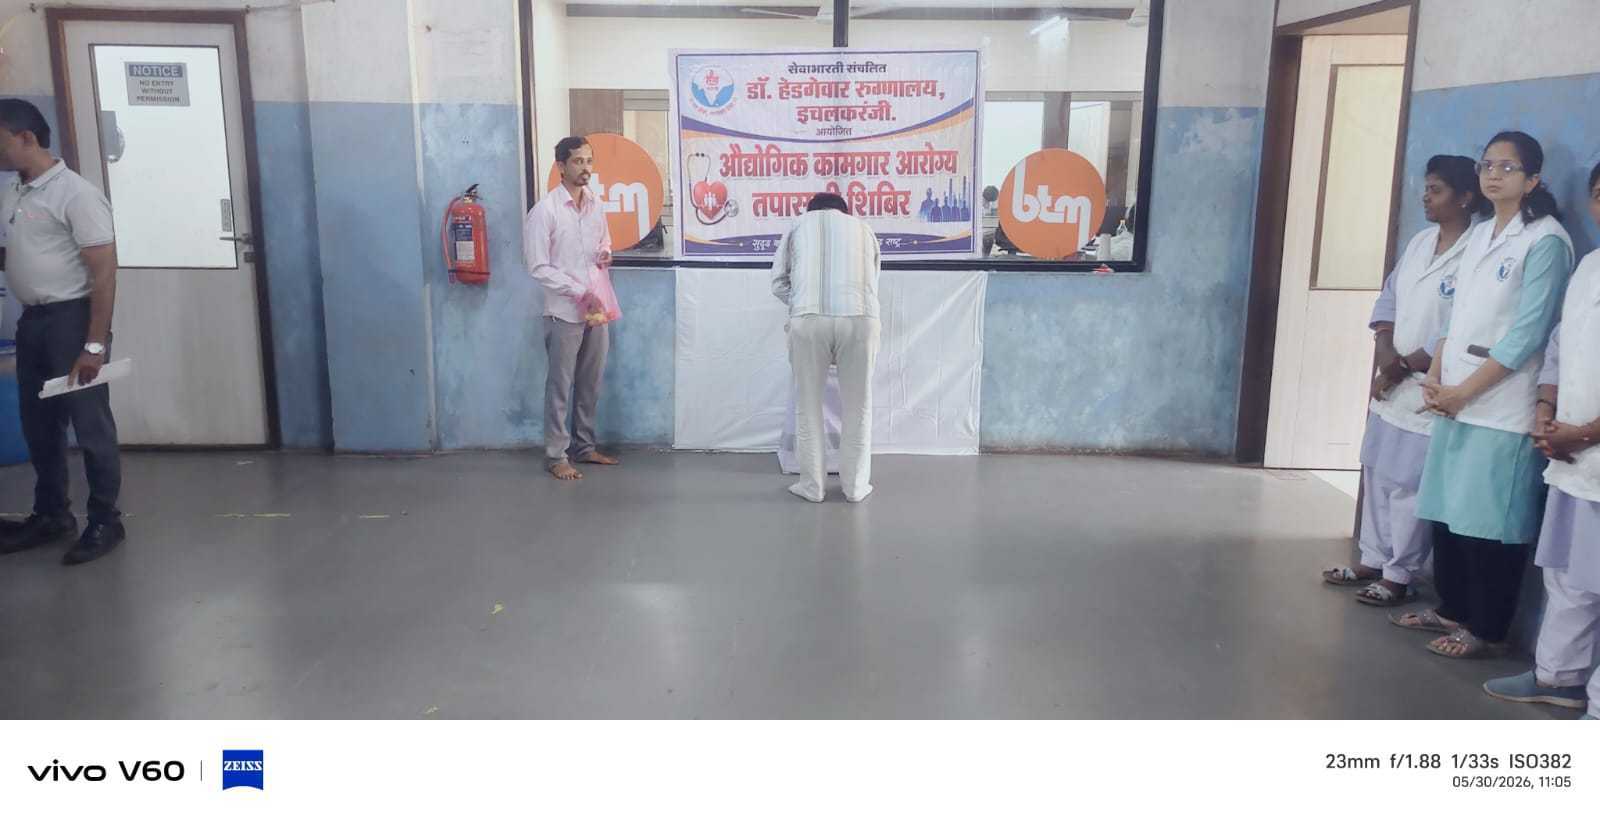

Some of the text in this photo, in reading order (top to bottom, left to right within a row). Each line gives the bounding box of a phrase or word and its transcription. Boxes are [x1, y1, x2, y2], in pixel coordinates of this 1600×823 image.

[132, 66, 180, 76] NOTICE
[788, 61, 887, 74] सेवाभारती संचलित
[746, 76, 772, 100] डॉ.
[778, 77, 851, 99] हेडगेवार
[855, 80, 945, 100] रुग्णालय,
[796, 100, 897, 124] इचलकरंजी.
[816, 125, 851, 136] आयोजित
[719, 141, 959, 177] औद्योगिक कामगार आरोग्य
[846, 181, 911, 216] शिबिर
[1012, 157, 1091, 251] btm
